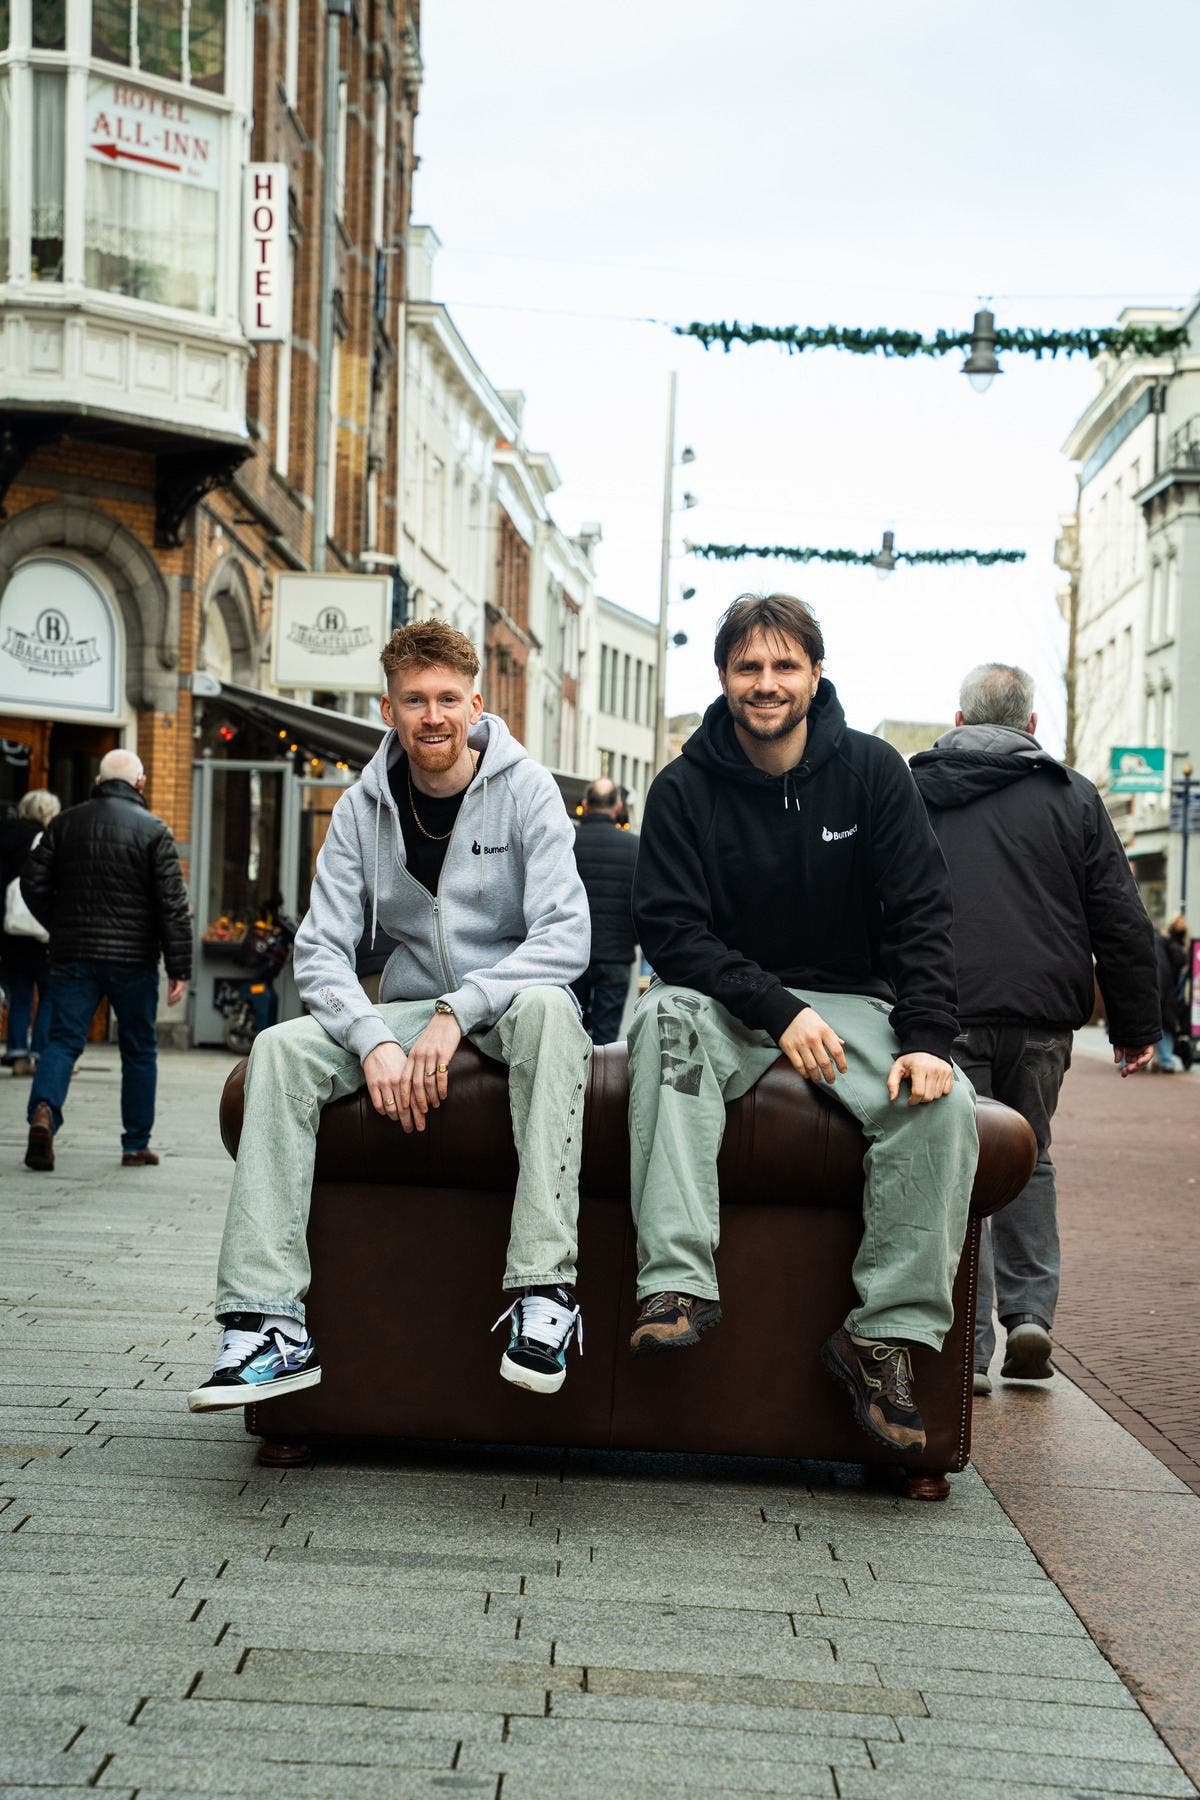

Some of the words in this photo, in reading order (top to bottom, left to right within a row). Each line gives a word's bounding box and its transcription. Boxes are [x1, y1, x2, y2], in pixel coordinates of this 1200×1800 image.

[113, 82, 190, 124] HOTEL
[92, 112, 209, 161] ALL-INN
[253, 173, 274, 329] HOTEL
[483, 842, 509, 855] Burned
[833, 823, 858, 841] Burned
